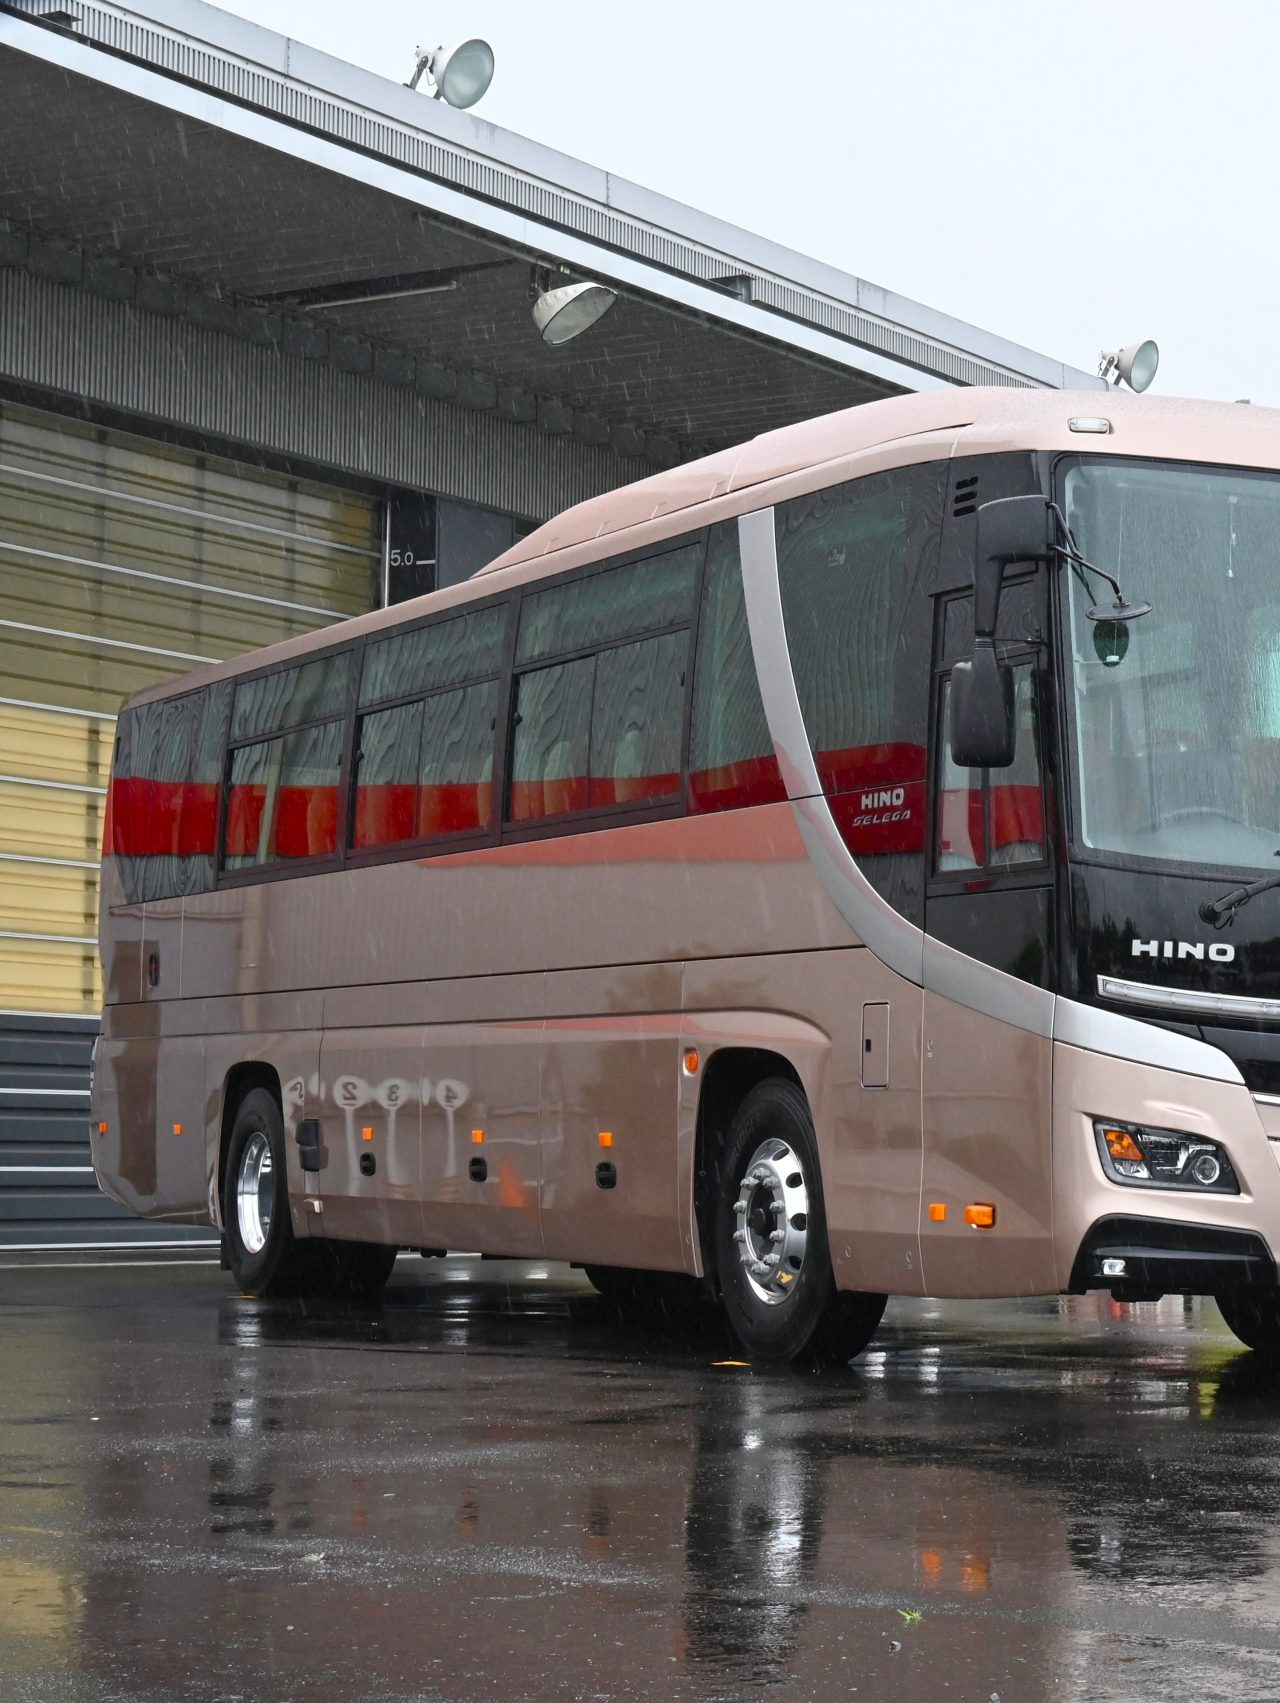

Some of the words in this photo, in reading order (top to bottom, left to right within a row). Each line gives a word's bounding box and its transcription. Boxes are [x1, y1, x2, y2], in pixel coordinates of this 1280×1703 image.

[391, 550, 413, 566] 5.0
[861, 788, 904, 810] HINO
[852, 809, 911, 827] SELEGA
[1132, 939, 1235, 962] HINO
